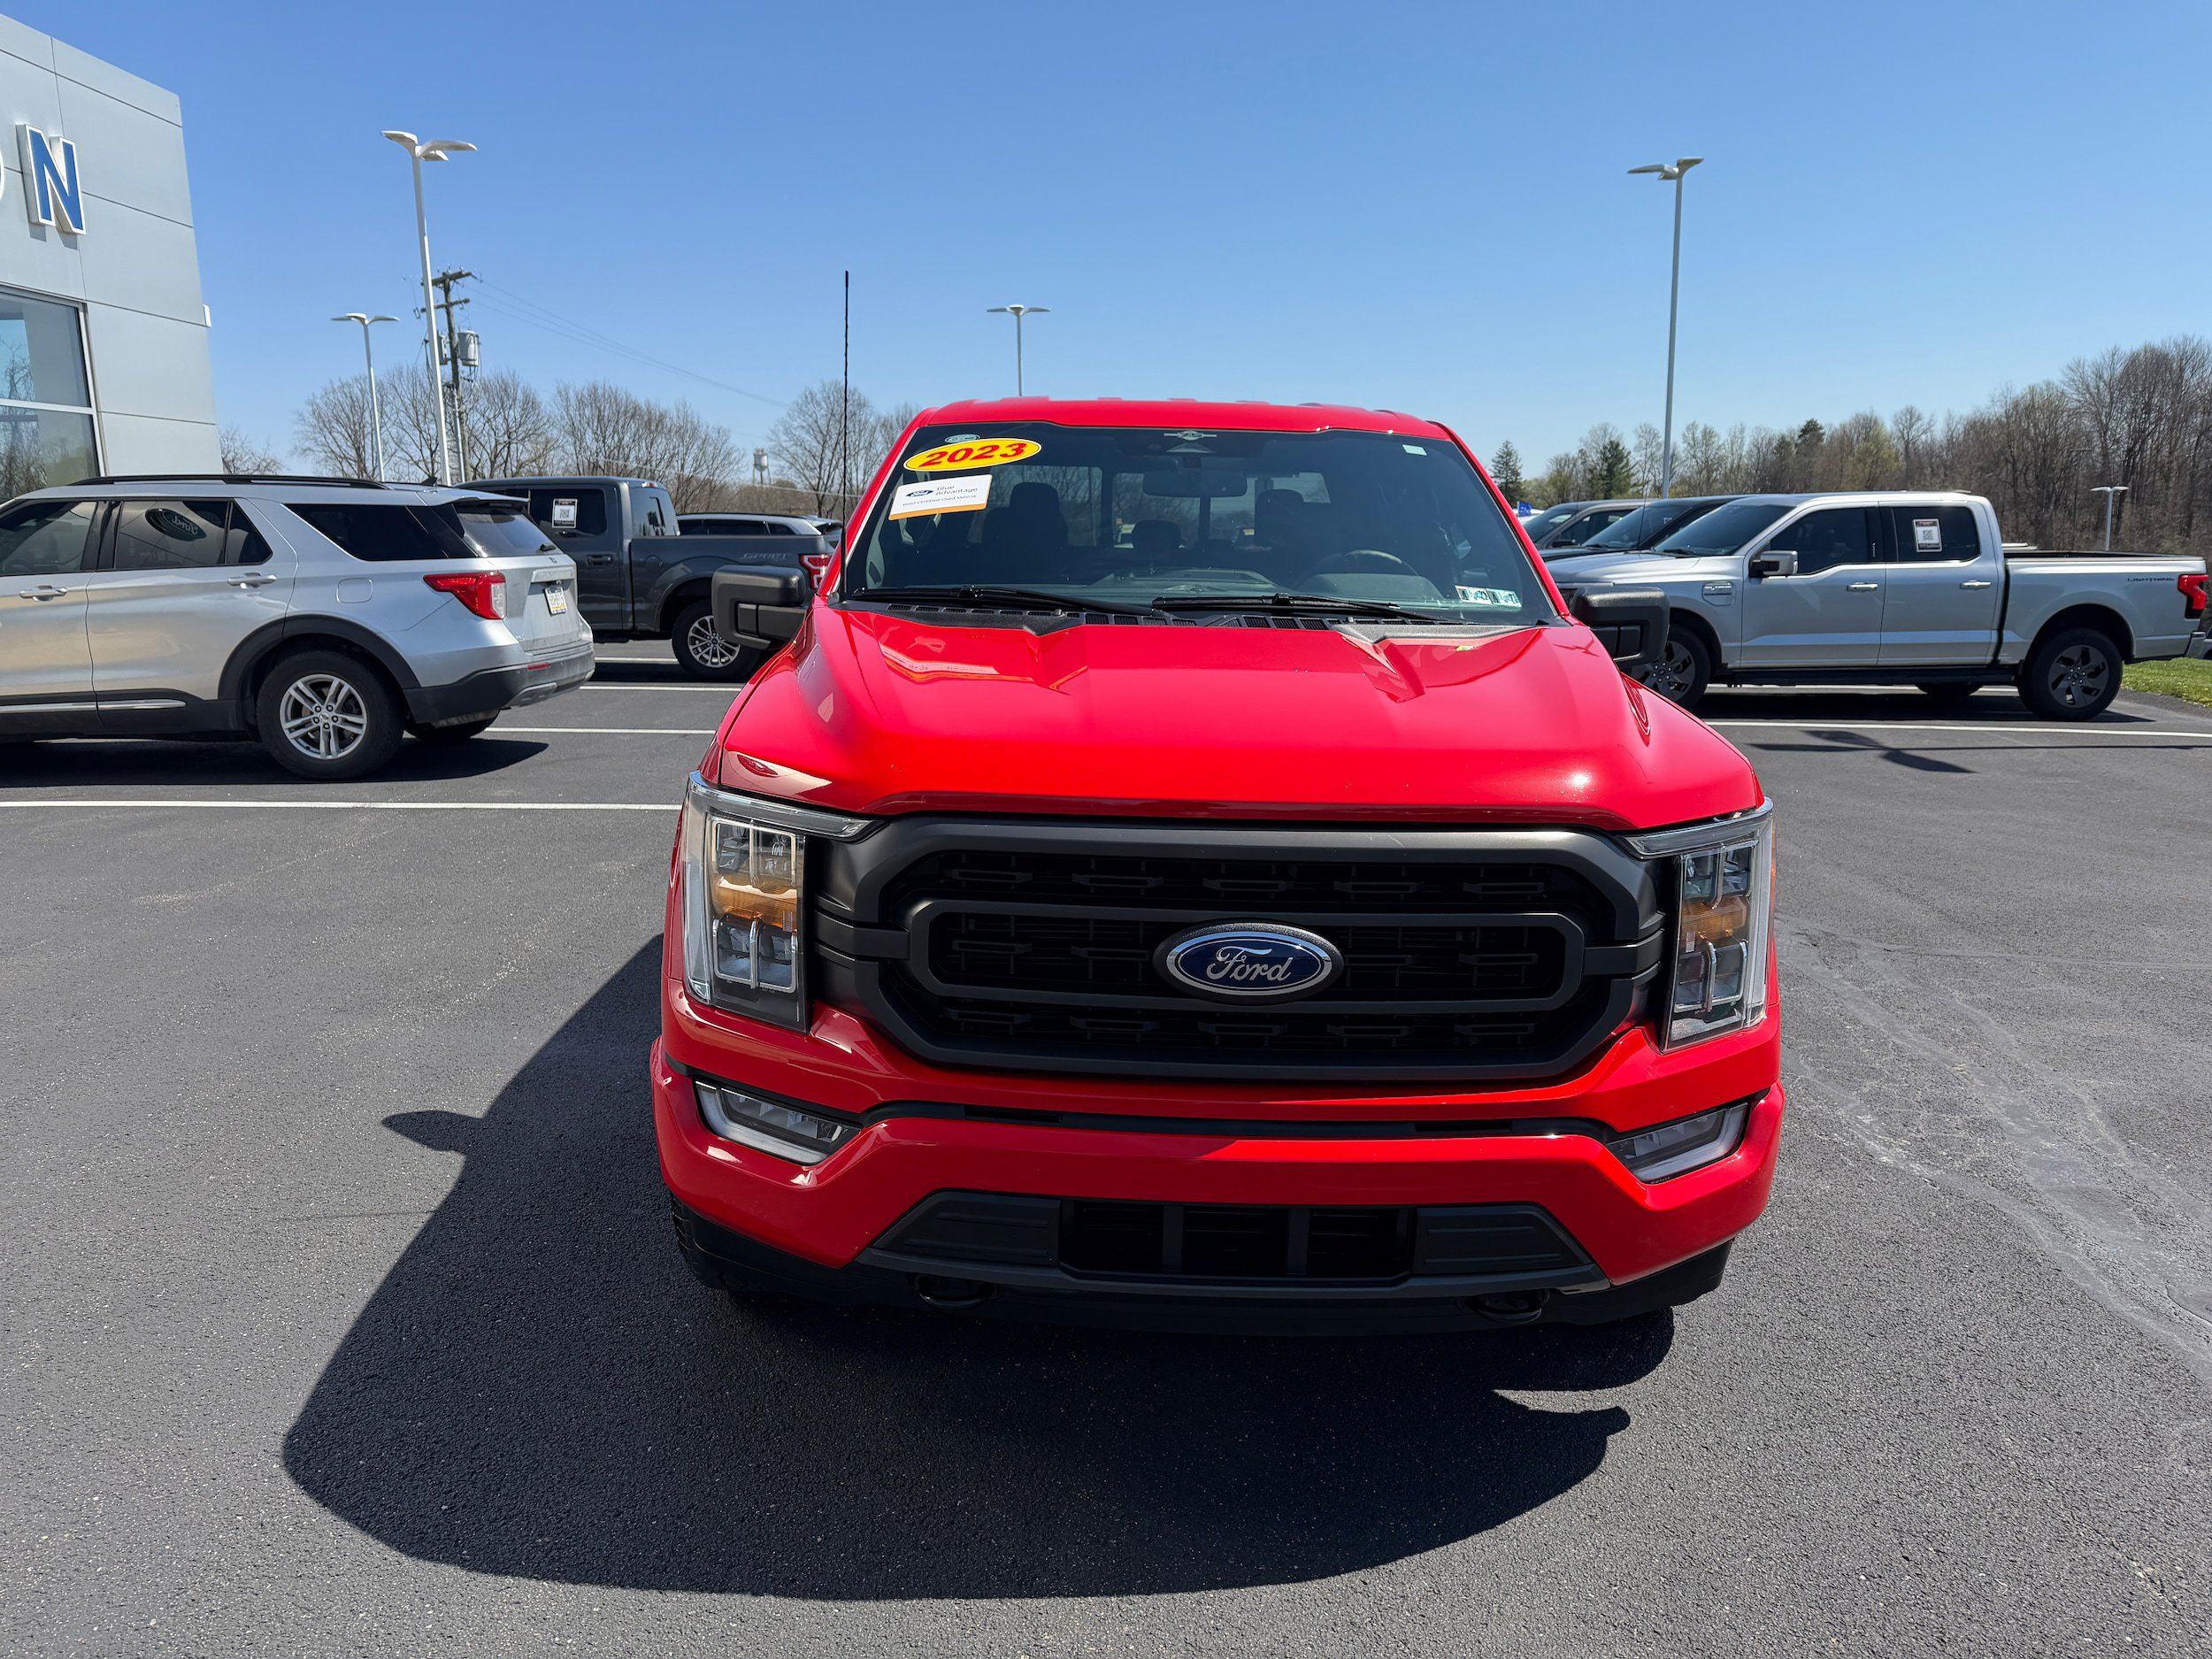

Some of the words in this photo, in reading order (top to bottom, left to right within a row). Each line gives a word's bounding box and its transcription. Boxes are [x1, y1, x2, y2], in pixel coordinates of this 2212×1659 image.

[0, 124, 86, 235] N
[918, 442, 1027, 468] 2023
[1206, 946, 1293, 981] Ford
